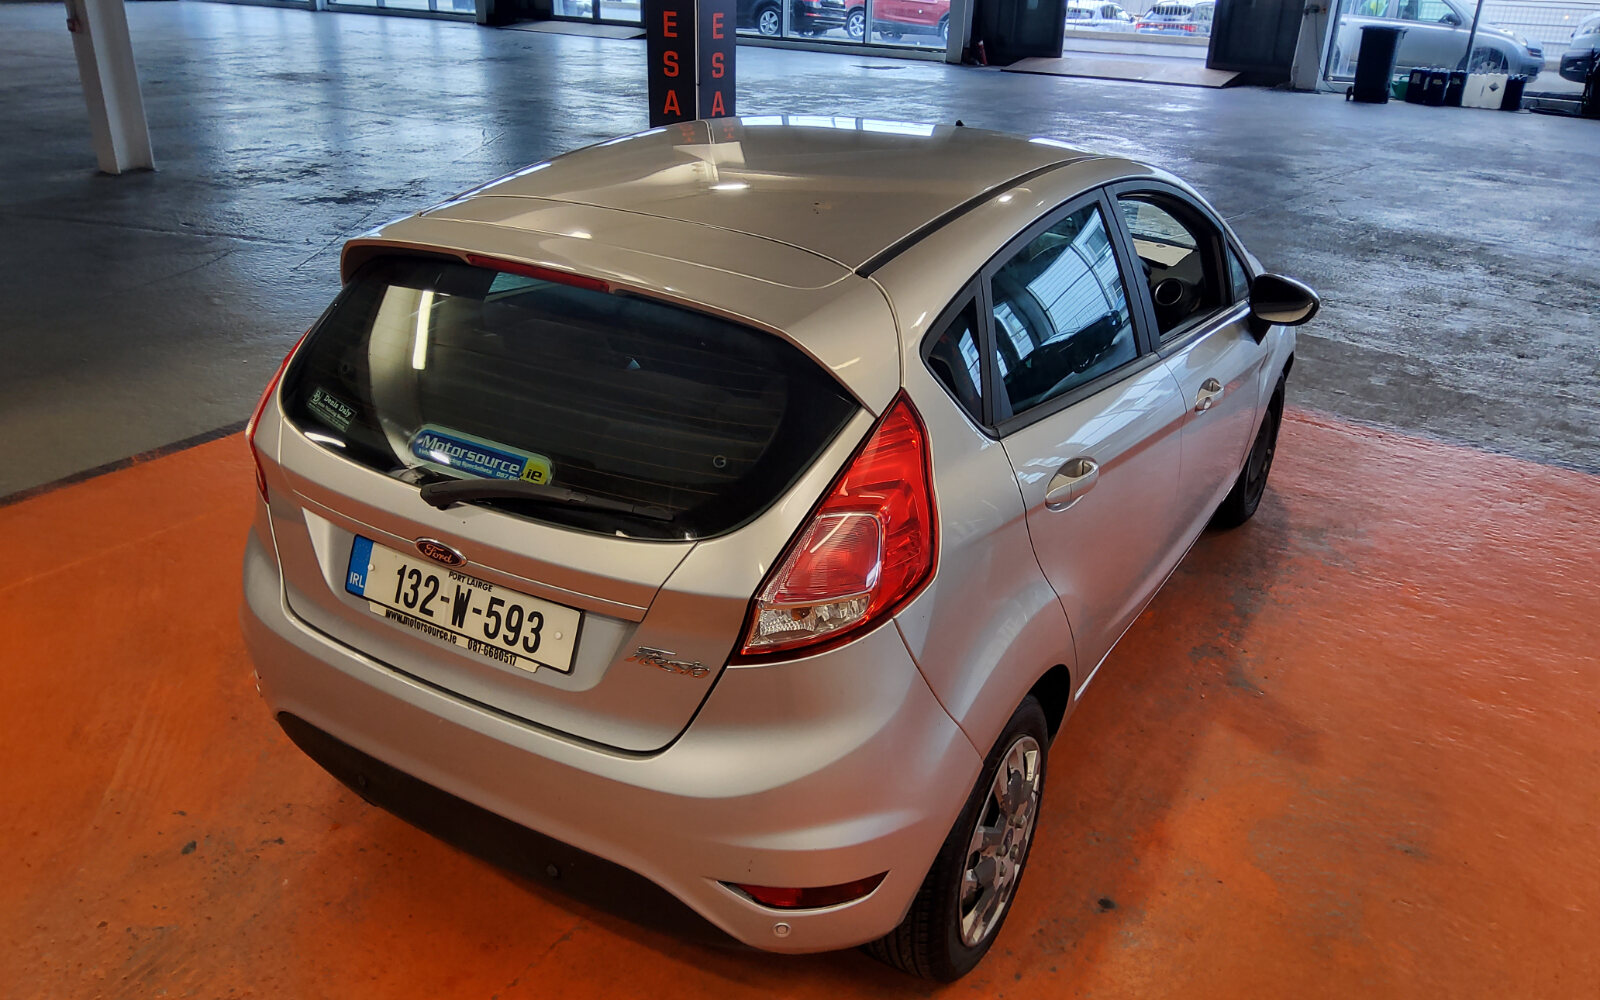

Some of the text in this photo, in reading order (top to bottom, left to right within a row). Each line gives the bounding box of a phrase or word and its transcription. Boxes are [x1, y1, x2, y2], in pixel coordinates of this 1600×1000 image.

[339, 404, 352, 418] Daly
[424, 543, 453, 564] Ford
[350, 571, 364, 588] IRL
[448, 571, 466, 583] PORT
[394, 564, 544, 654] 132-W-593
[385, 608, 518, 667] www.motorsource.ie 087-6680517
